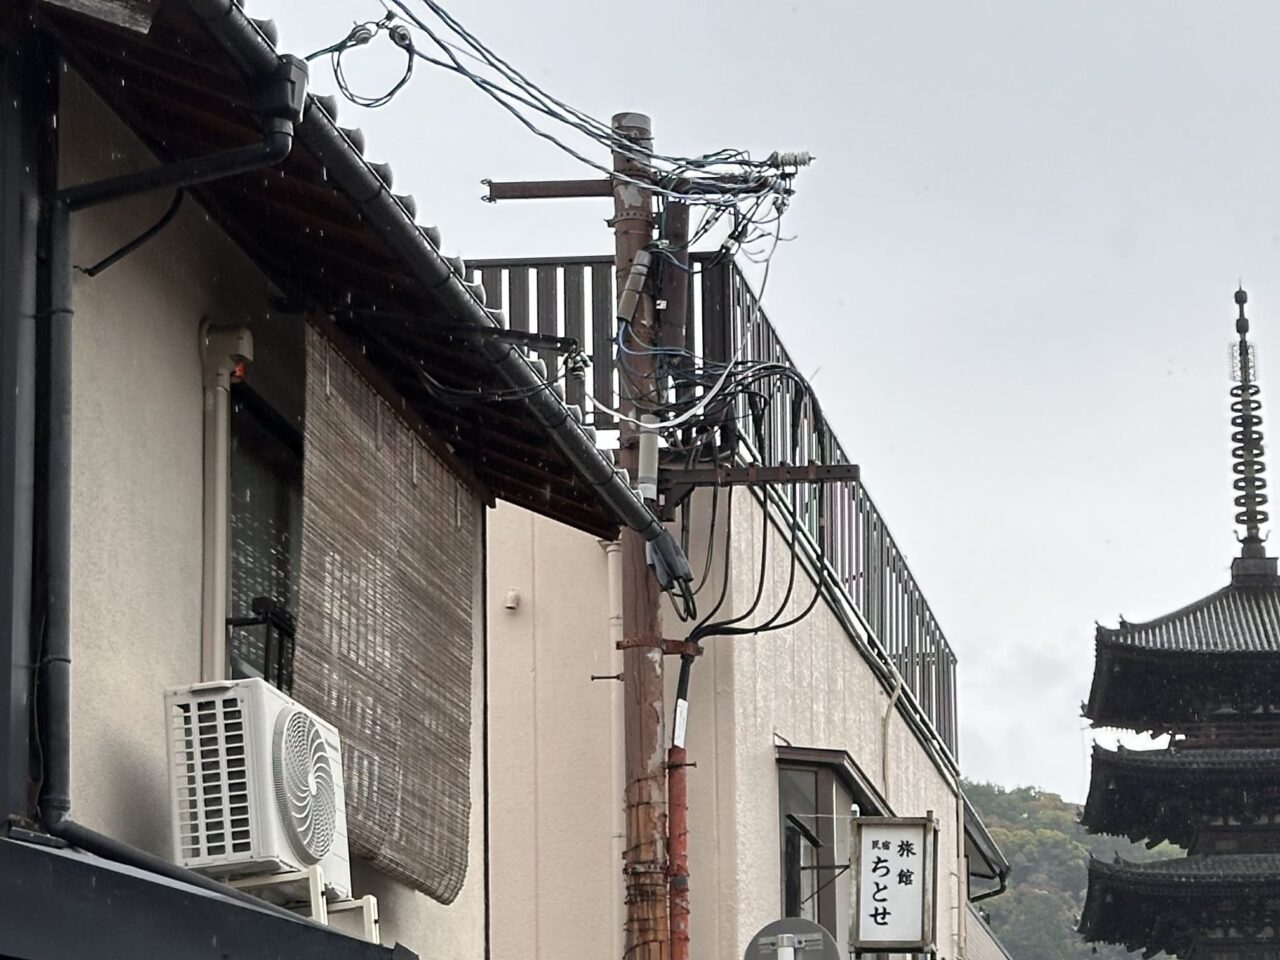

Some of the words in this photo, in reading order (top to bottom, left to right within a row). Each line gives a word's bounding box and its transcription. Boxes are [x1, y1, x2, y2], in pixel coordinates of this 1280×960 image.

[871, 840, 892, 851] 民宿
[897, 840, 917, 886] 旅館
[869, 856, 892, 926] ちとせ
